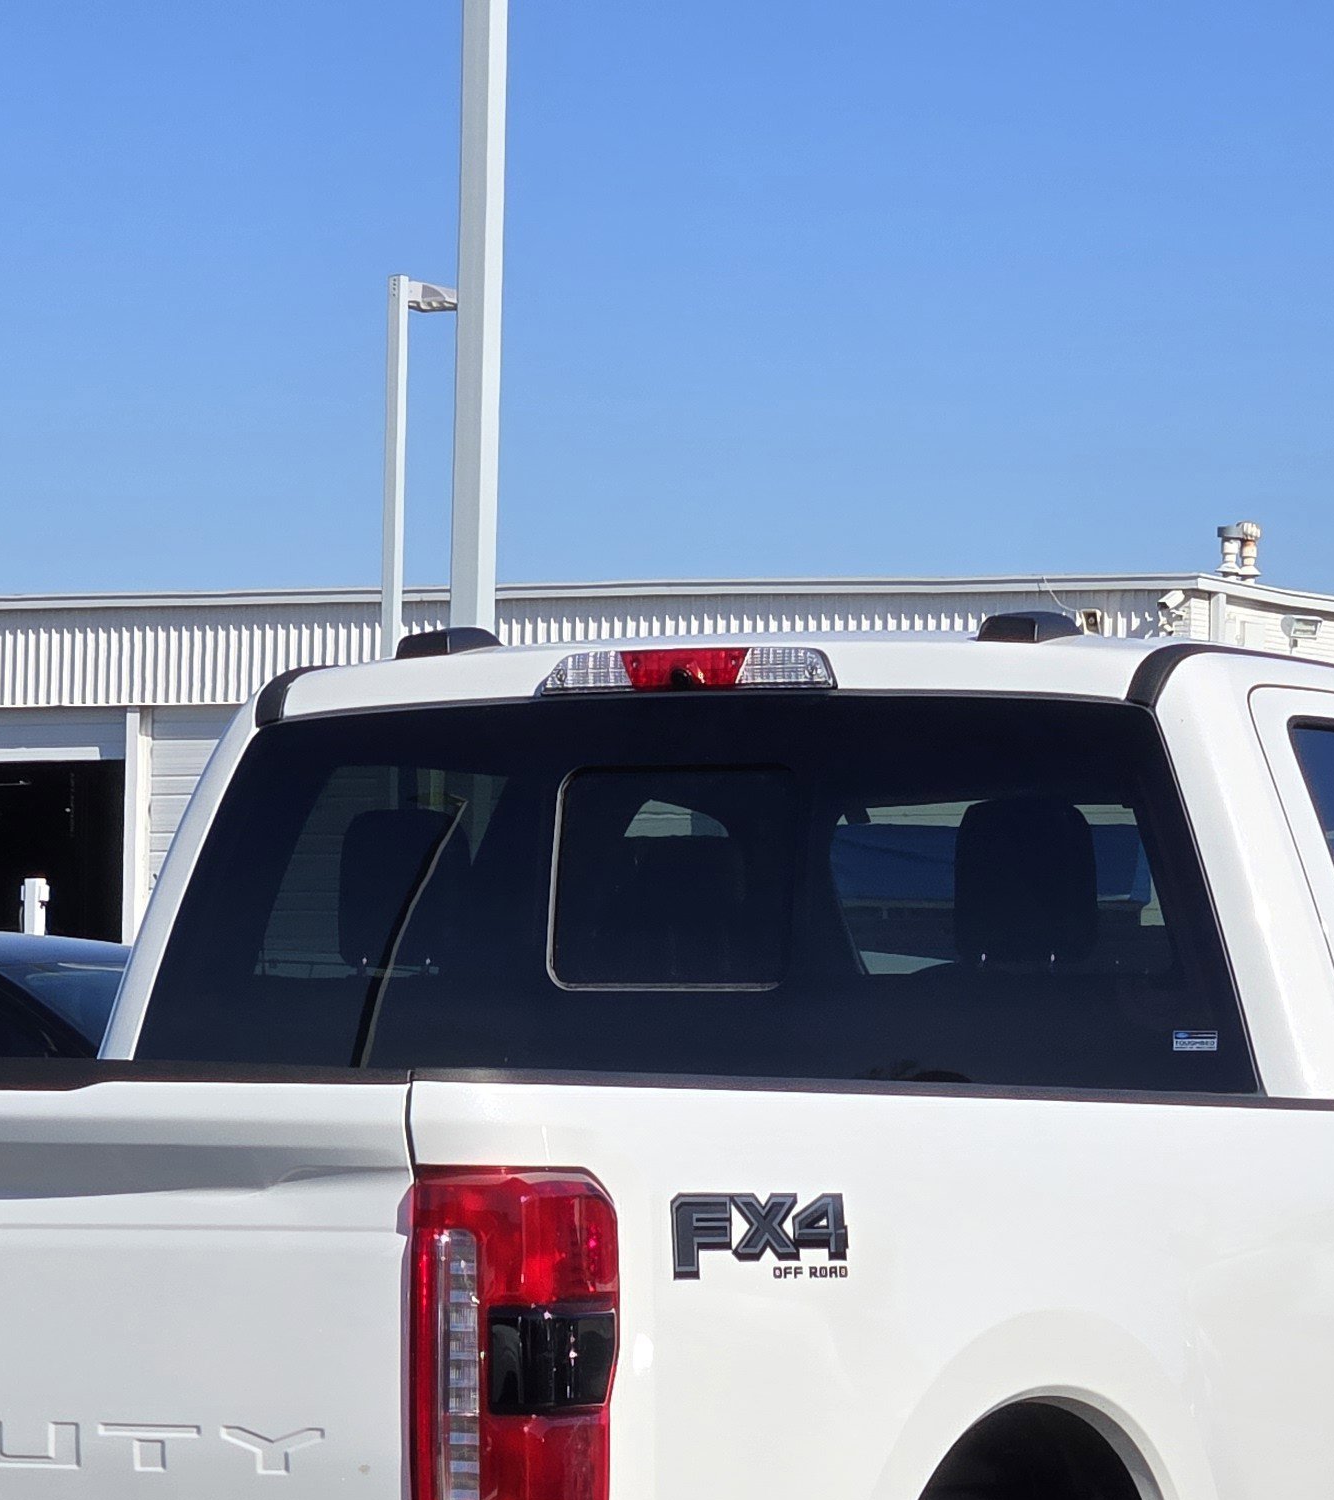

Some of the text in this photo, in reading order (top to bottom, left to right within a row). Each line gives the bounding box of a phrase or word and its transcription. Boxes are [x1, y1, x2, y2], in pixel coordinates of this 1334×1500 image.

[670, 1193, 848, 1280] FX4
[773, 1266, 848, 1278] OFF ROAD
